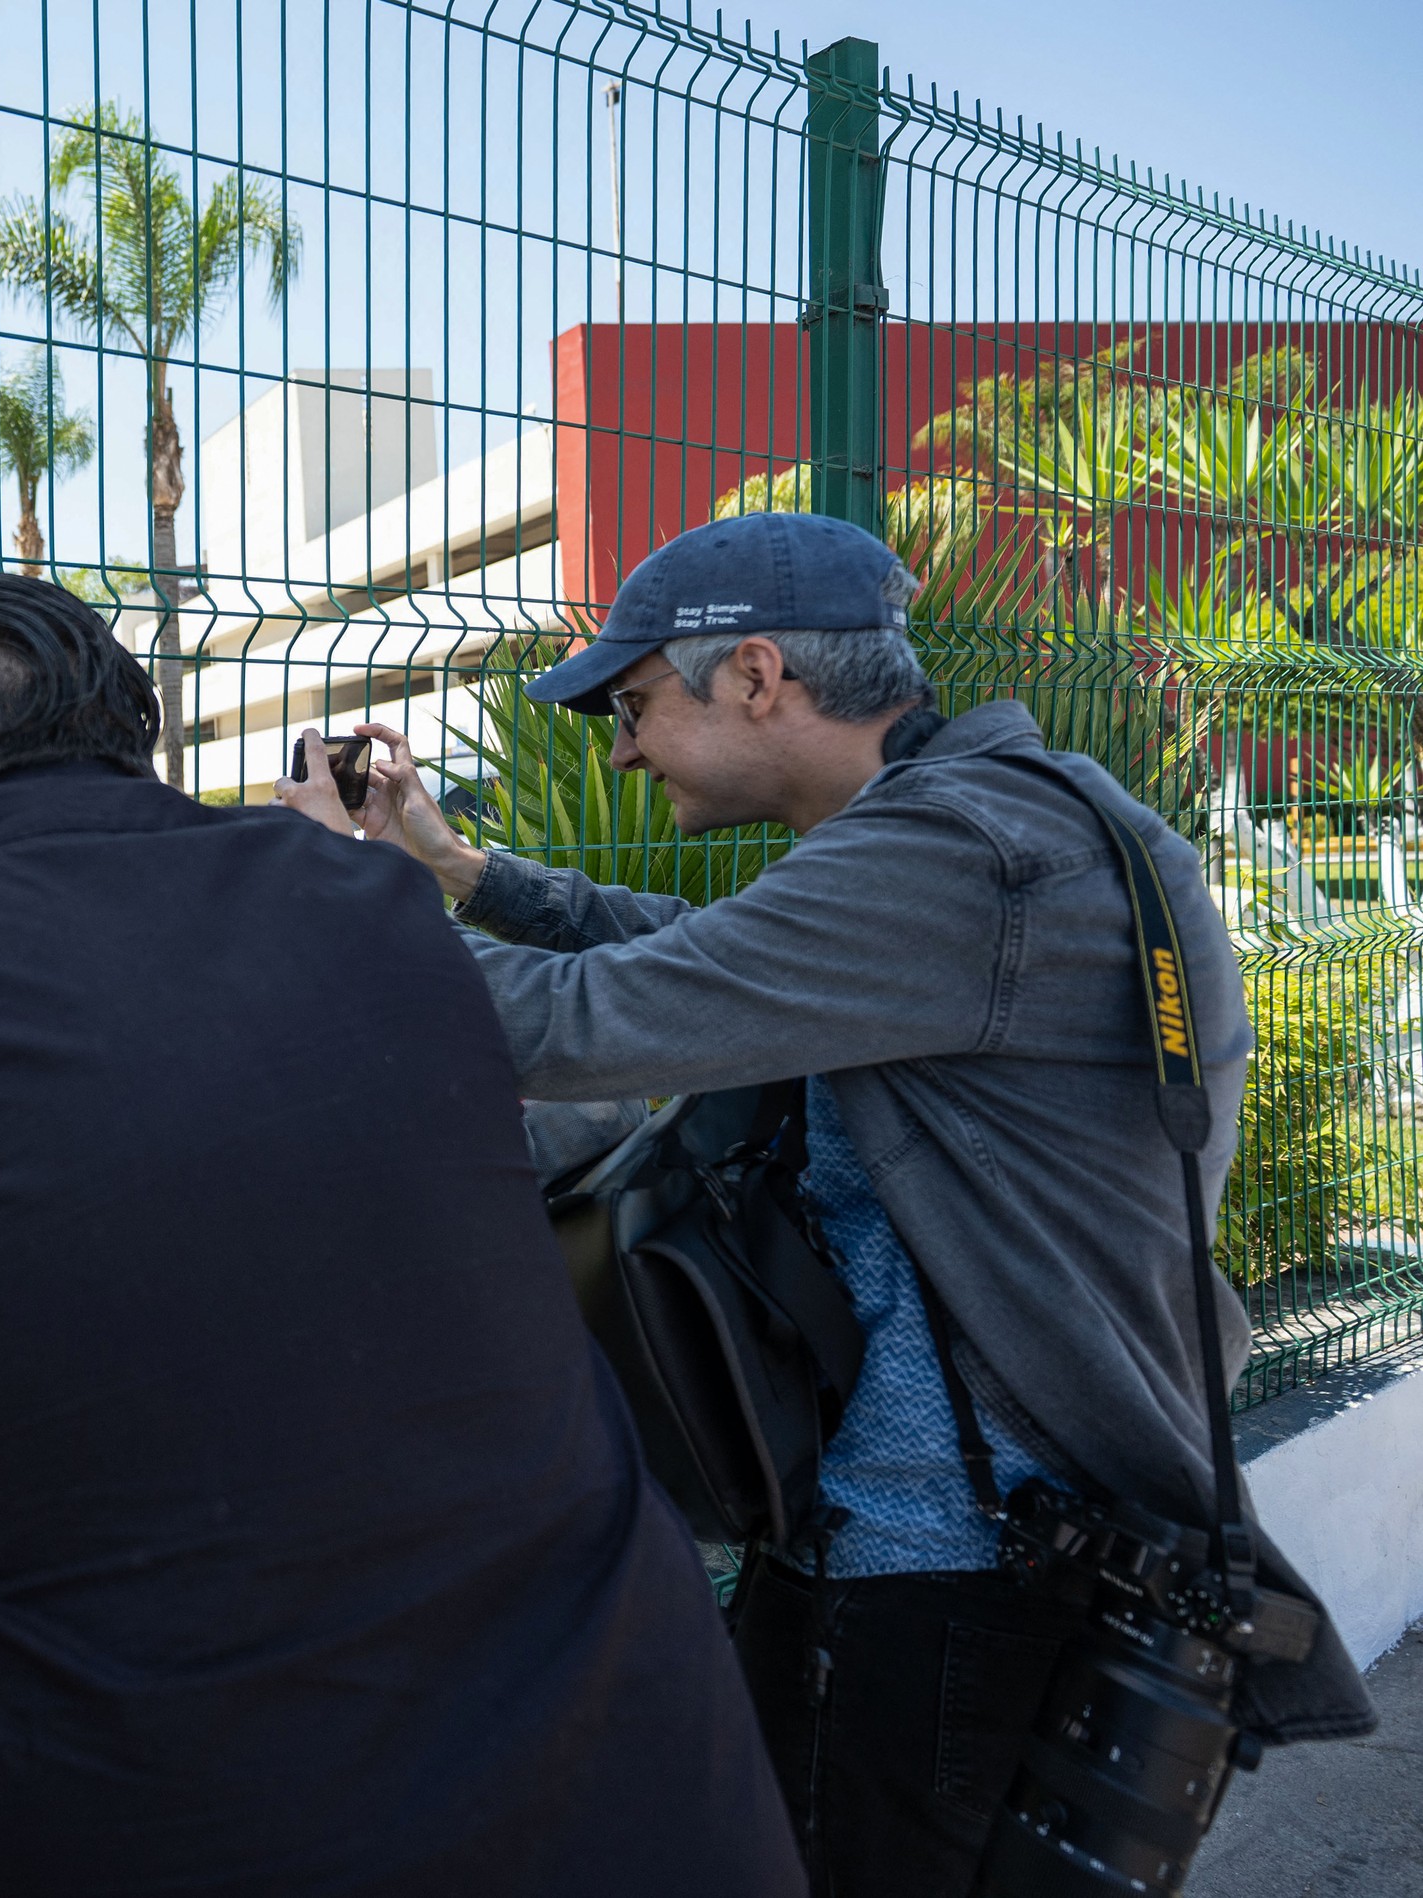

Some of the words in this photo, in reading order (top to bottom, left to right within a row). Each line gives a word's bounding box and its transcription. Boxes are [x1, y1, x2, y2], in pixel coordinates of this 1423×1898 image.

[676, 606, 703, 617] Stay
[706, 602, 753, 614] Simple
[673, 618, 702, 628] Stay
[704, 615, 739, 626] True.
[1152, 947, 1189, 1058] Nikon
